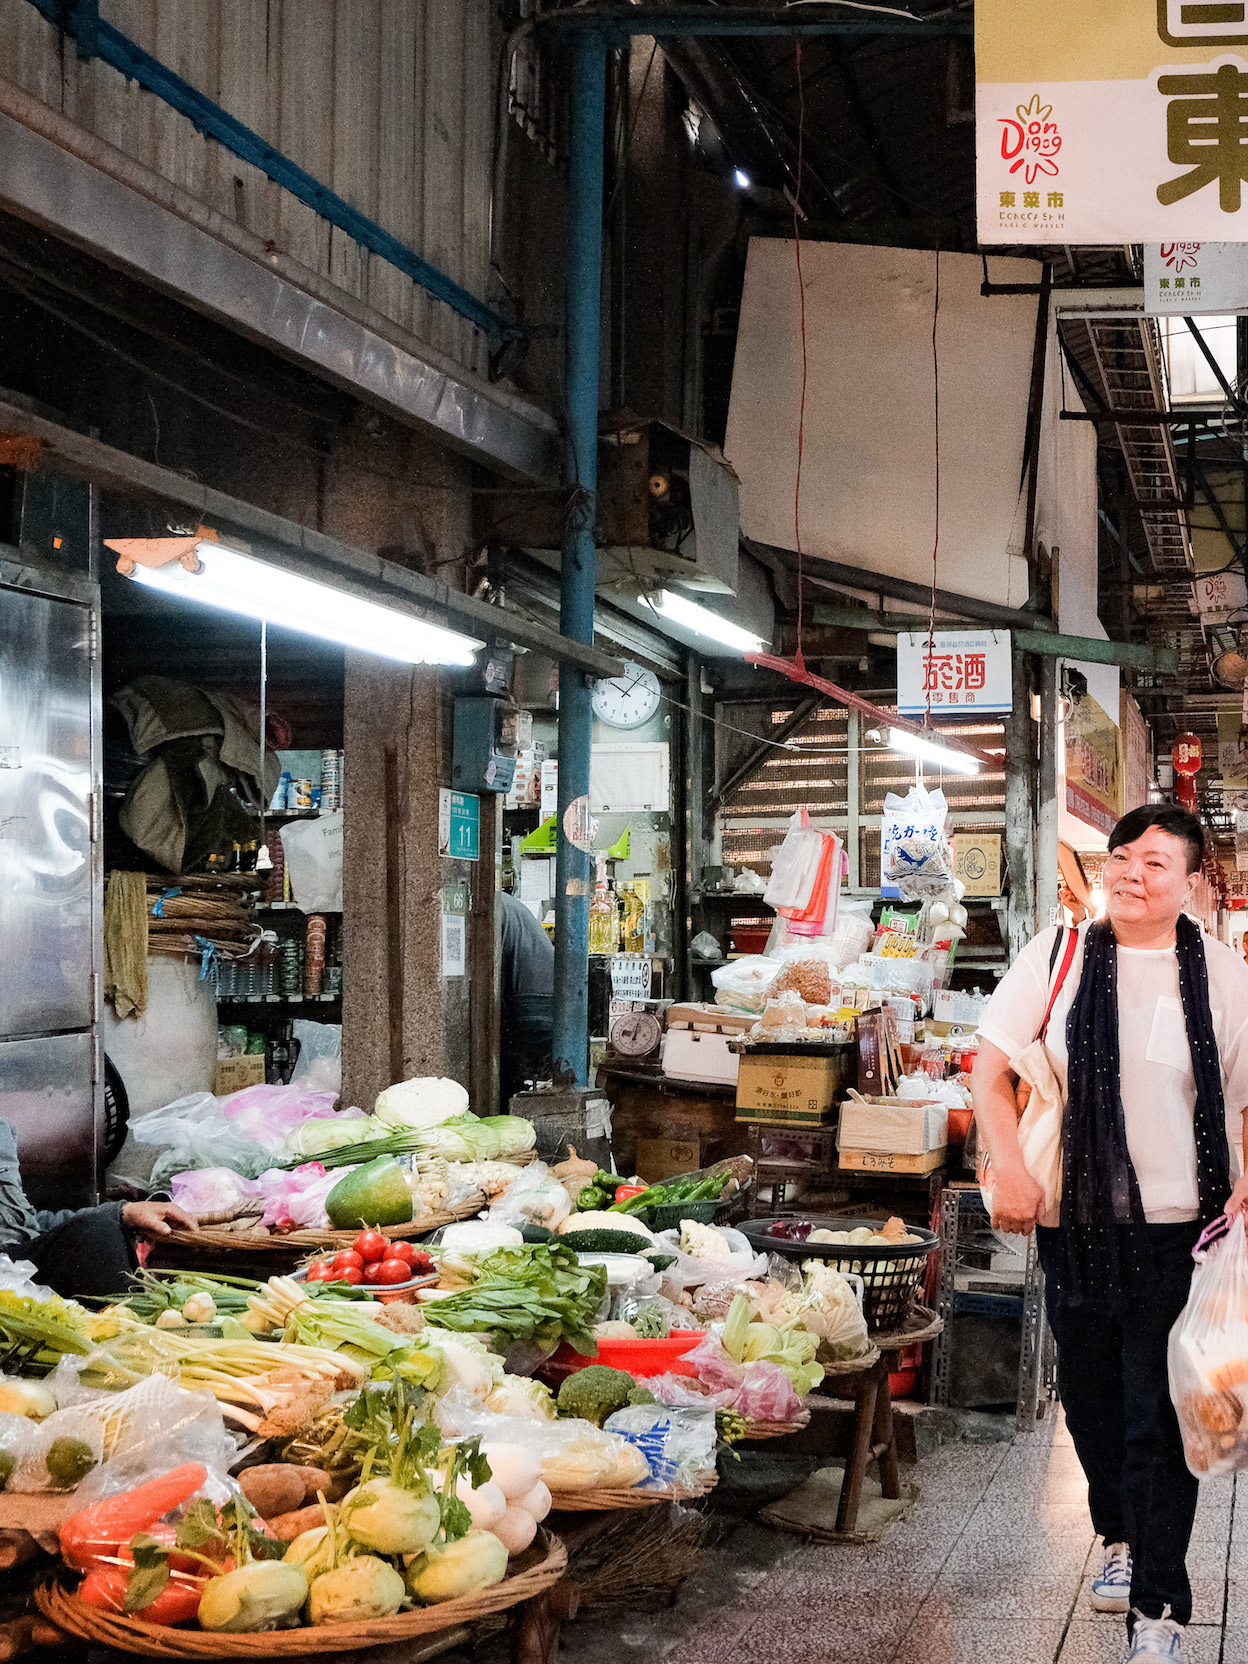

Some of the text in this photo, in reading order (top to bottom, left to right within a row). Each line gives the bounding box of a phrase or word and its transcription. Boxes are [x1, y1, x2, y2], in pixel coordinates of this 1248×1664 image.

[999, 191, 1064, 208] 東菜市
[1159, 277, 1201, 289] 東菜市
[922, 653, 986, 690] 菸酒
[932, 692, 975, 704] 零售商
[322, 824, 344, 837] Fami
[459, 825, 471, 848] 11
